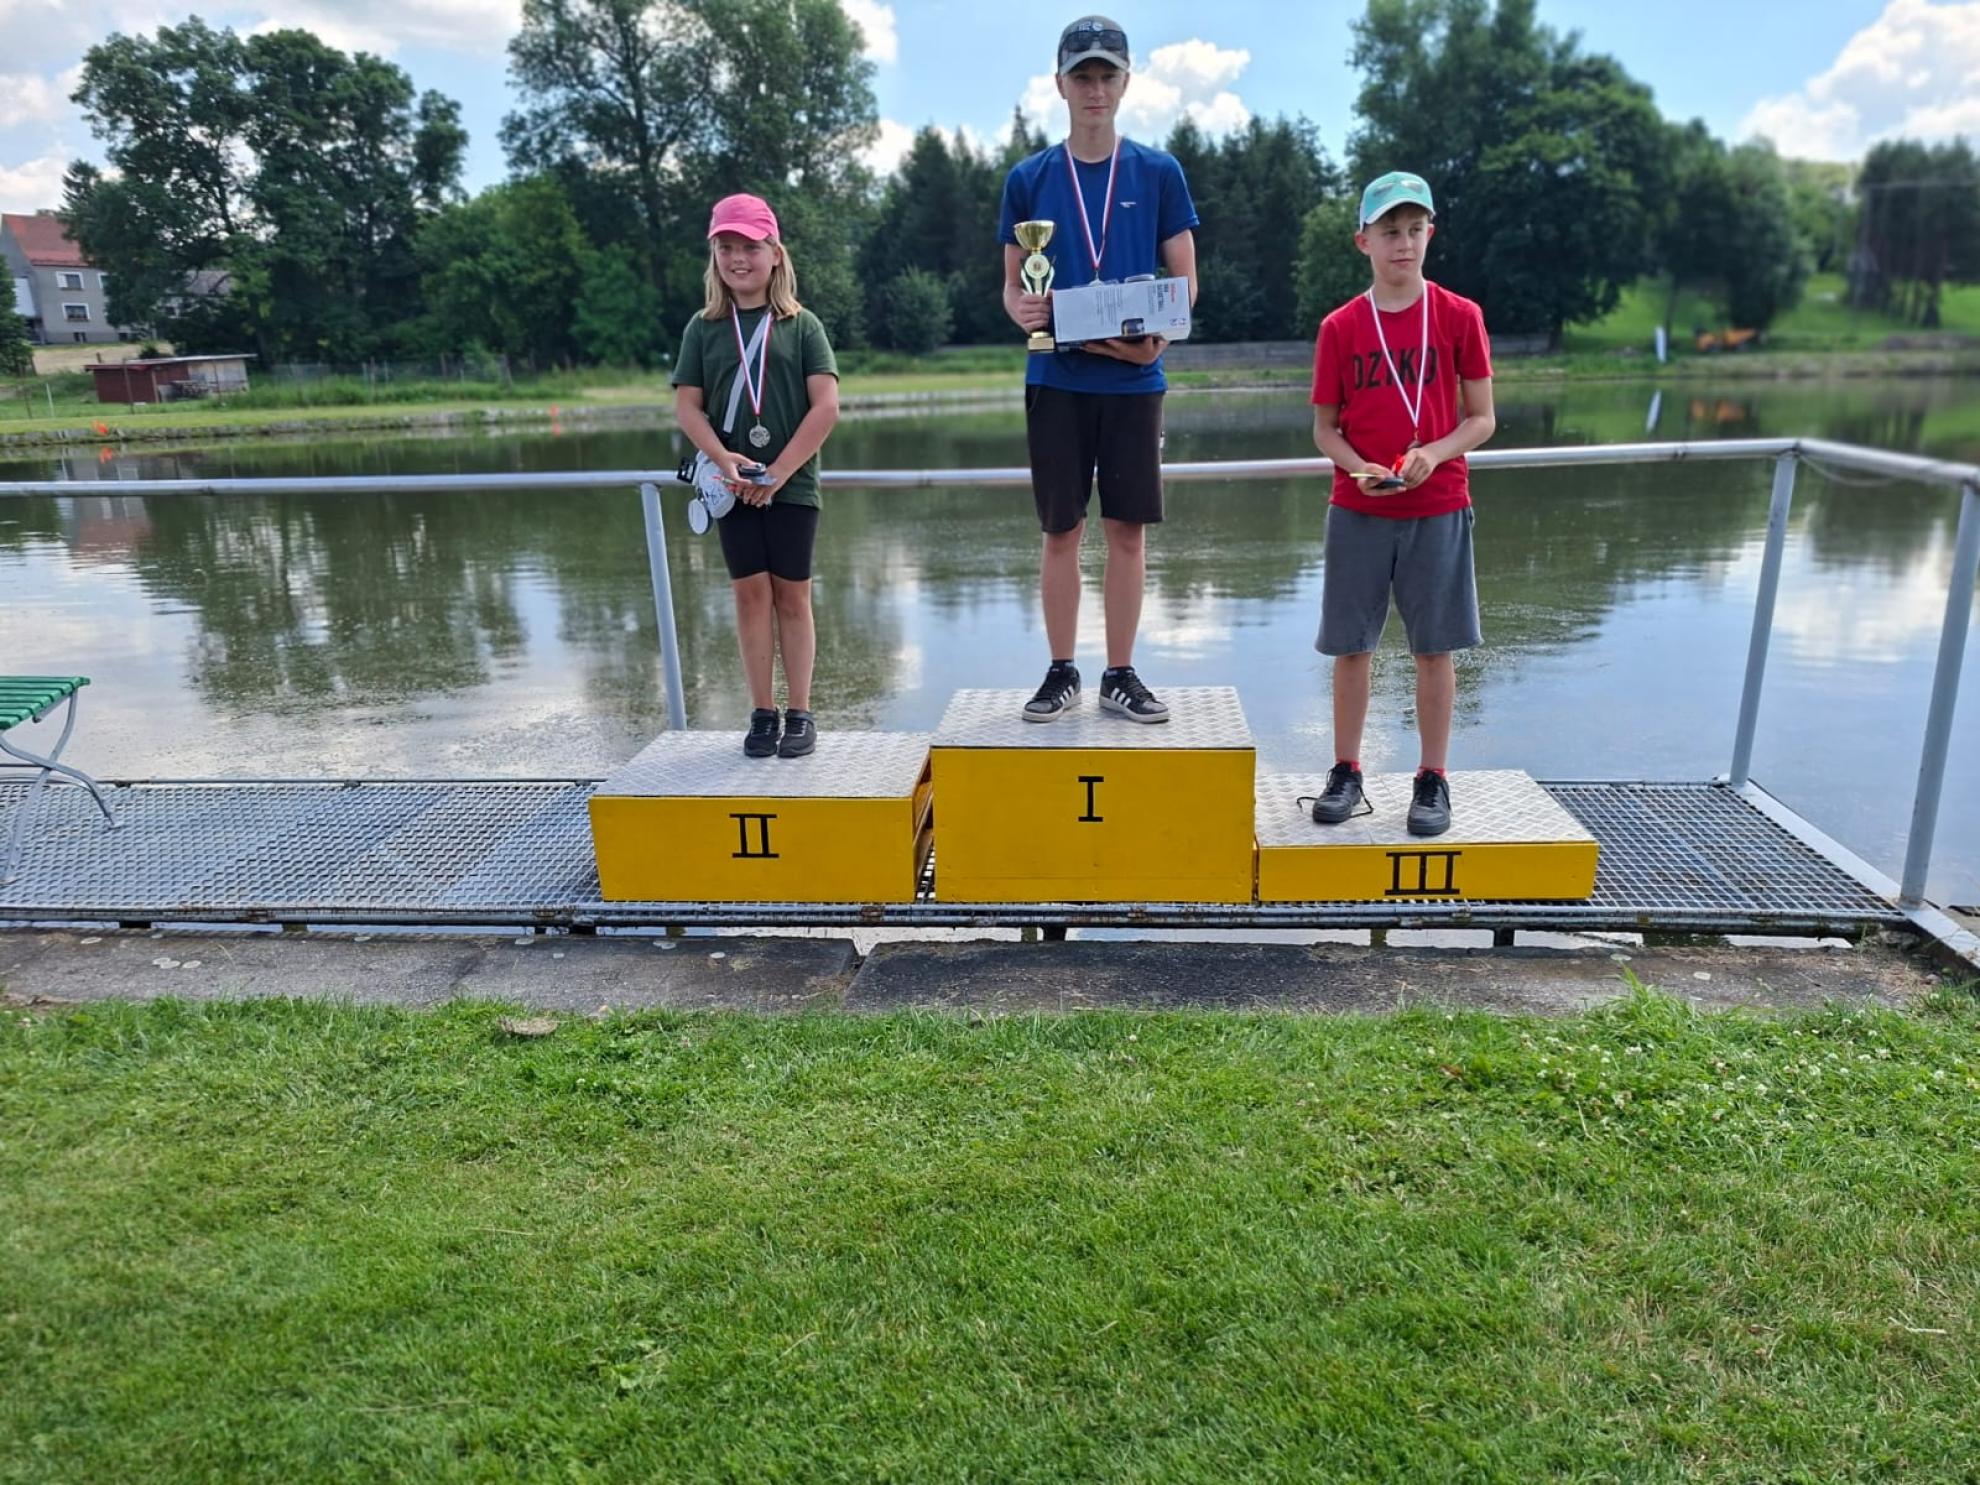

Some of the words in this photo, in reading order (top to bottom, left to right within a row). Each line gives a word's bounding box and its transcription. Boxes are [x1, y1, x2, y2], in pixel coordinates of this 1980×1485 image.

[1078, 776, 1105, 822] I
[729, 813, 780, 858] II
[1384, 851, 1462, 896] III
